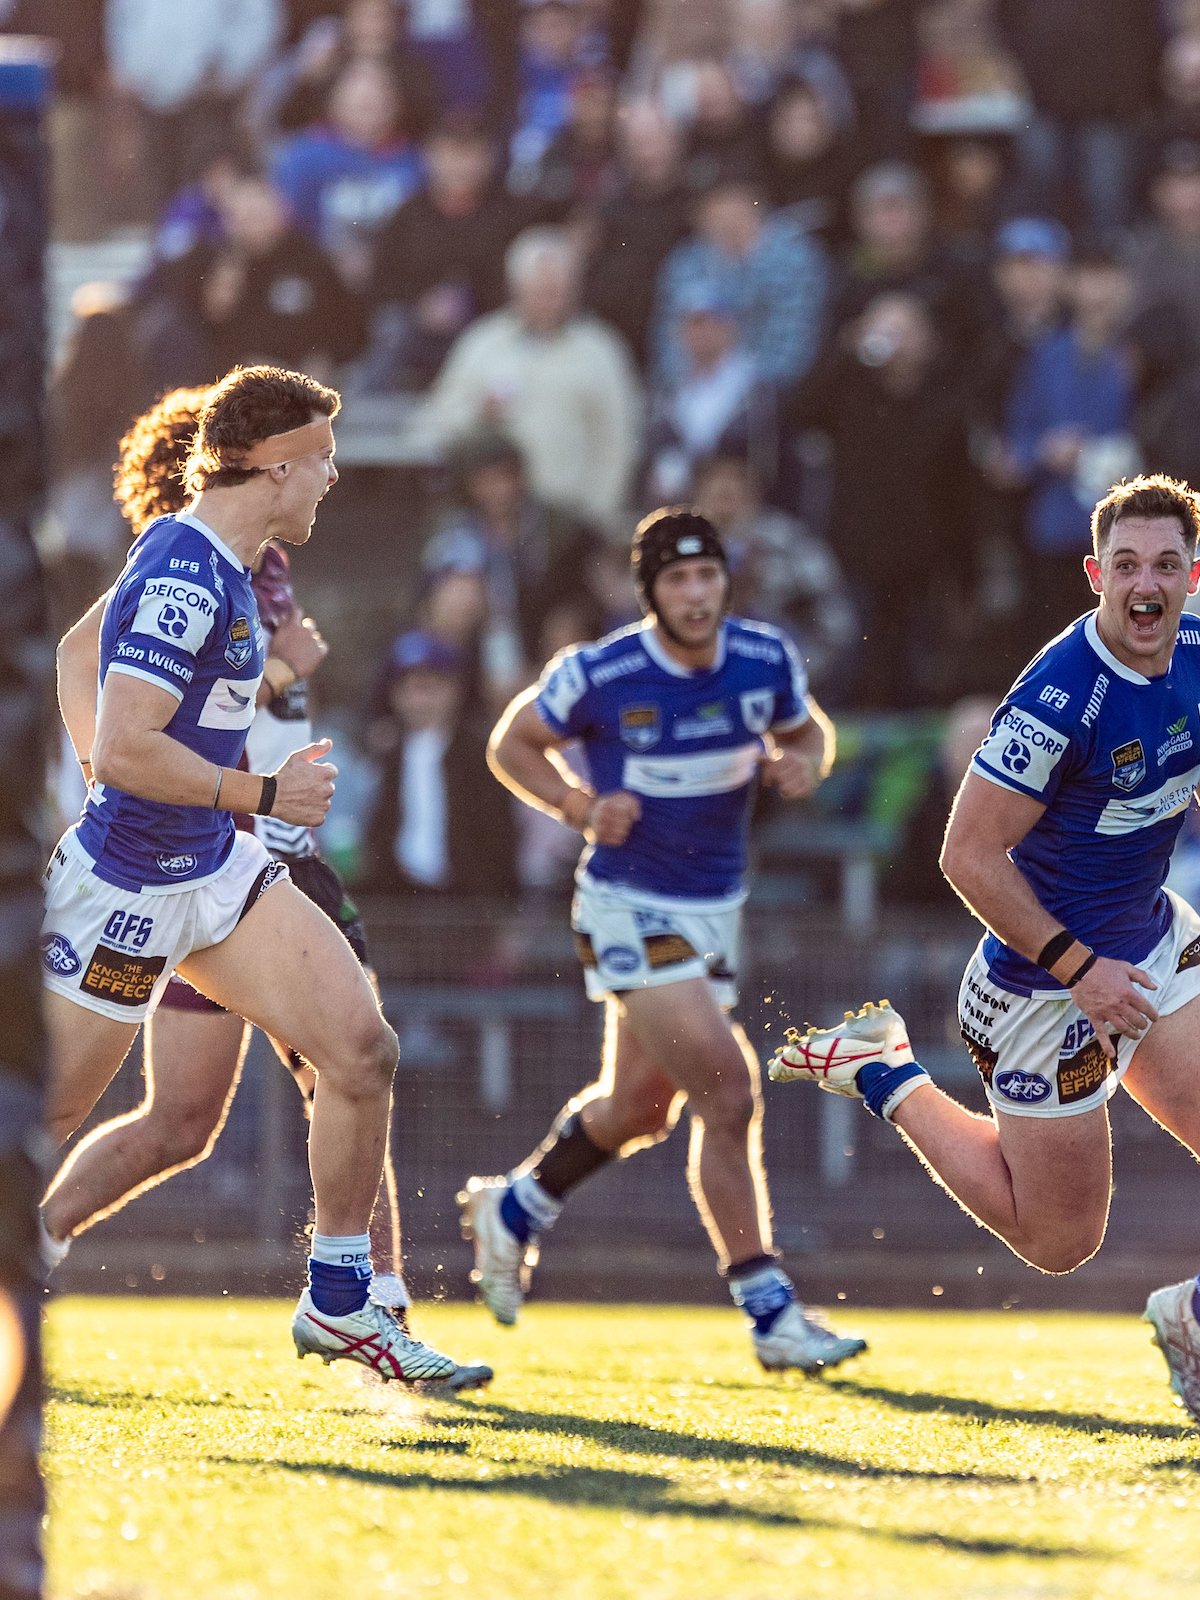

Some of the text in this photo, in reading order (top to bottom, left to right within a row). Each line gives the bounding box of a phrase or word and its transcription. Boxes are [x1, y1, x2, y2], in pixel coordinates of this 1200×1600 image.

[169, 558, 200, 573] GFS
[117, 642, 194, 684] Ken Wilson
[1039, 684, 1070, 710] GFS
[1081, 673, 1110, 728] PHILTER
[1003, 713, 1063, 756] DEICORP
[103, 910, 154, 947] GFS
[123, 964, 143, 974] THE
[964, 999, 995, 1028] PARK
[1060, 1051, 1107, 1082] KNOCK-O
[1083, 1050, 1097, 1063] THE
[1000, 1078, 1046, 1097] JETS
[1061, 1061, 1105, 1096] EFFEC
